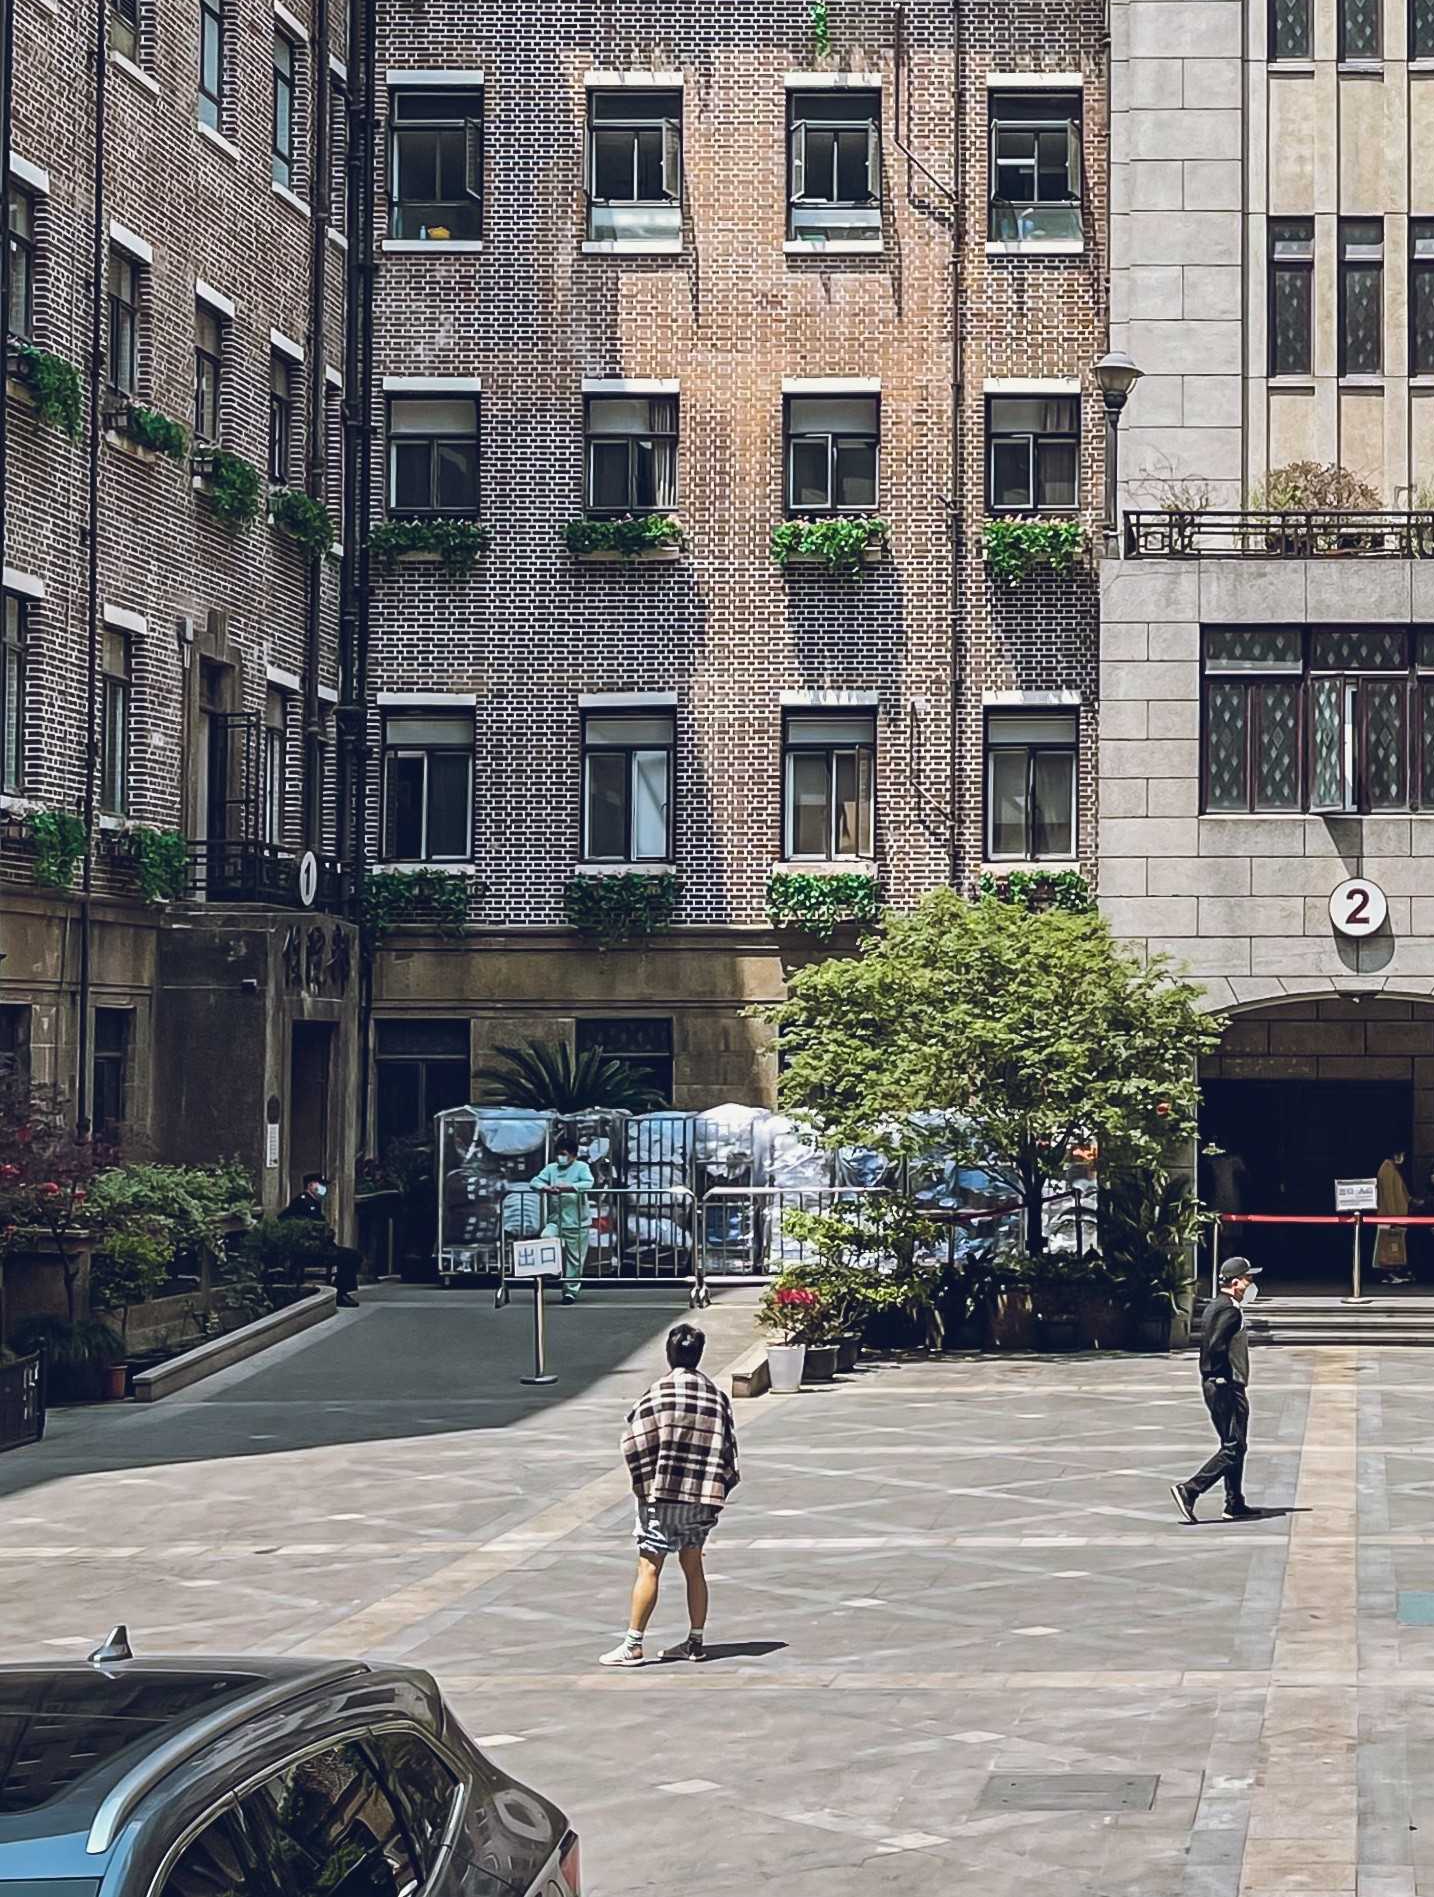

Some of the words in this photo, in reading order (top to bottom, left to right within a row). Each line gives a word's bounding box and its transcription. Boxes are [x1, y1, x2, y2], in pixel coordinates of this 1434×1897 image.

[304, 861, 311, 896] 1
[1345, 888, 1370, 925] 2
[518, 1247, 556, 1267] 出口
